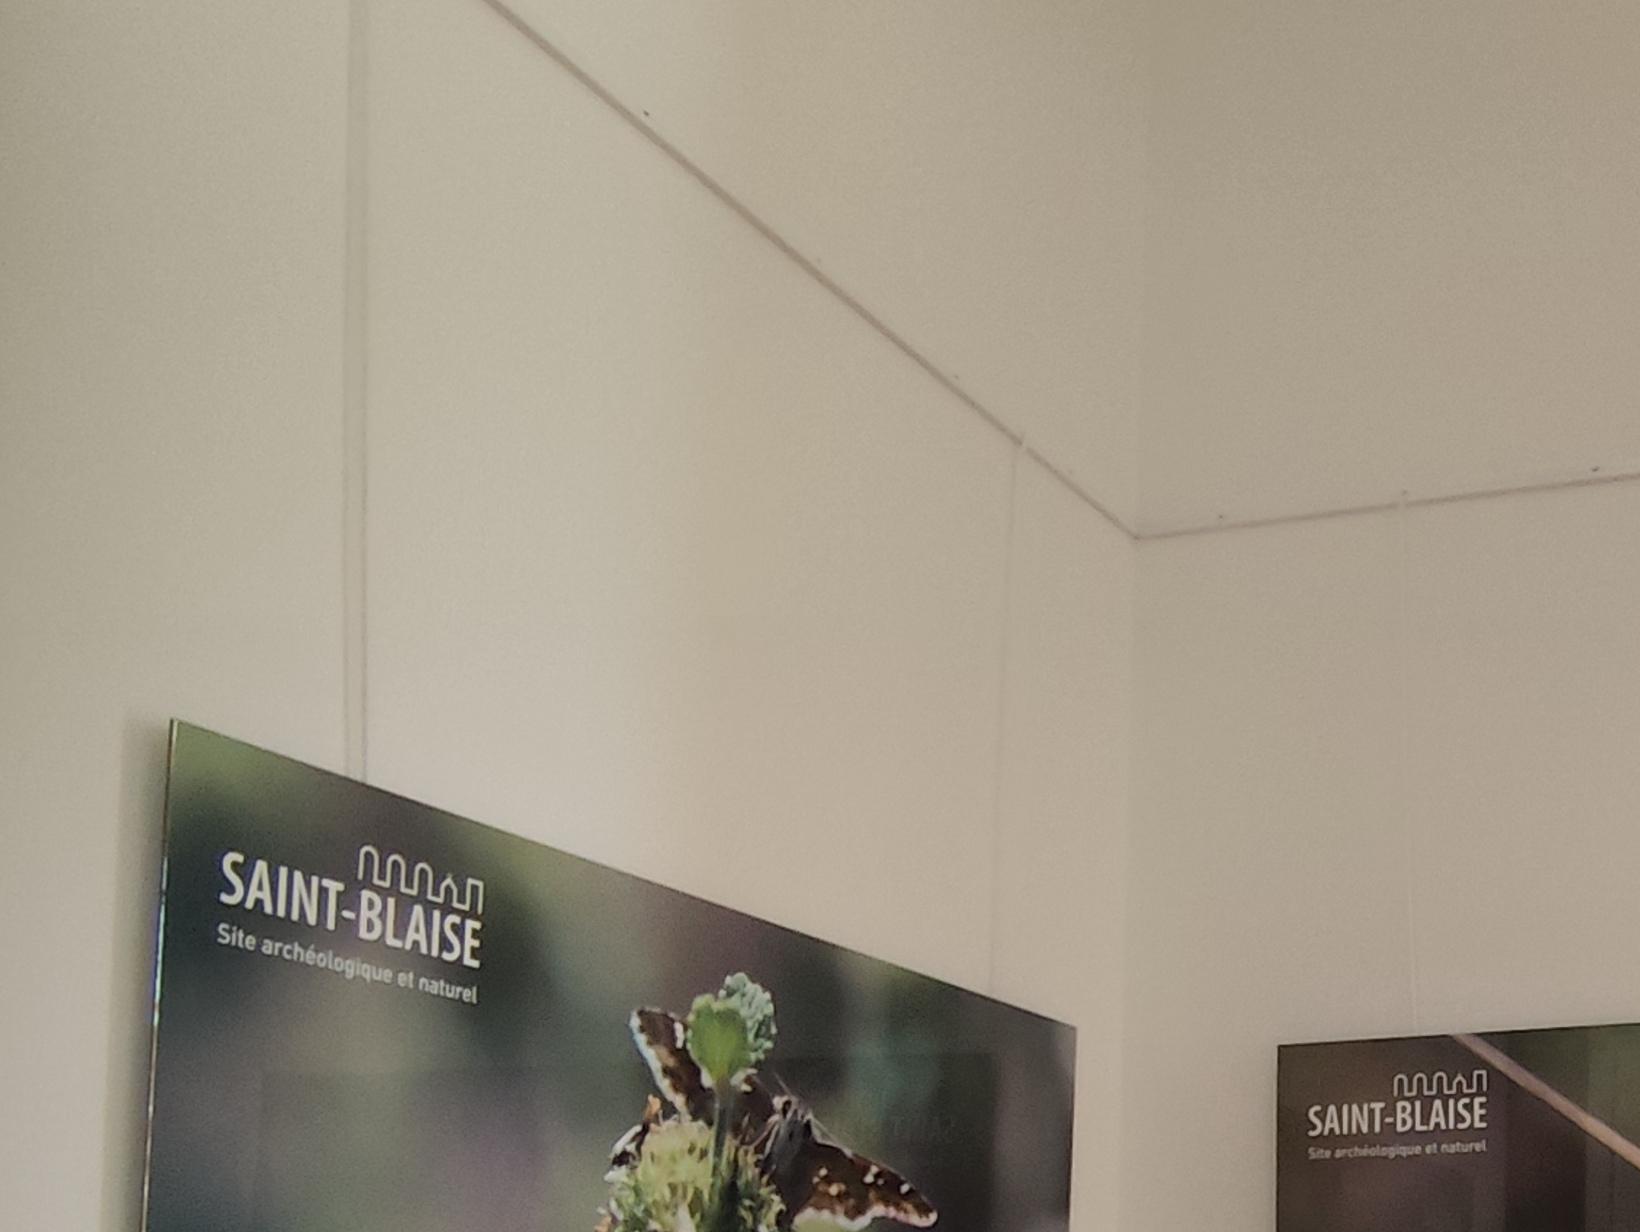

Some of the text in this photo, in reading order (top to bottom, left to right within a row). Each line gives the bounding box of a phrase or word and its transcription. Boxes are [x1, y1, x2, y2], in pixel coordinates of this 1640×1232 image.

[218, 851, 483, 969] SAINT-BLAISE
[216, 922, 478, 1005] Site archéologique et naturel
[1307, 1097, 1488, 1137] SAINT-BLAISE
[1307, 1146, 1332, 1160] Site
[1425, 1142, 1439, 1155] et
[1441, 1141, 1487, 1154] naturel
